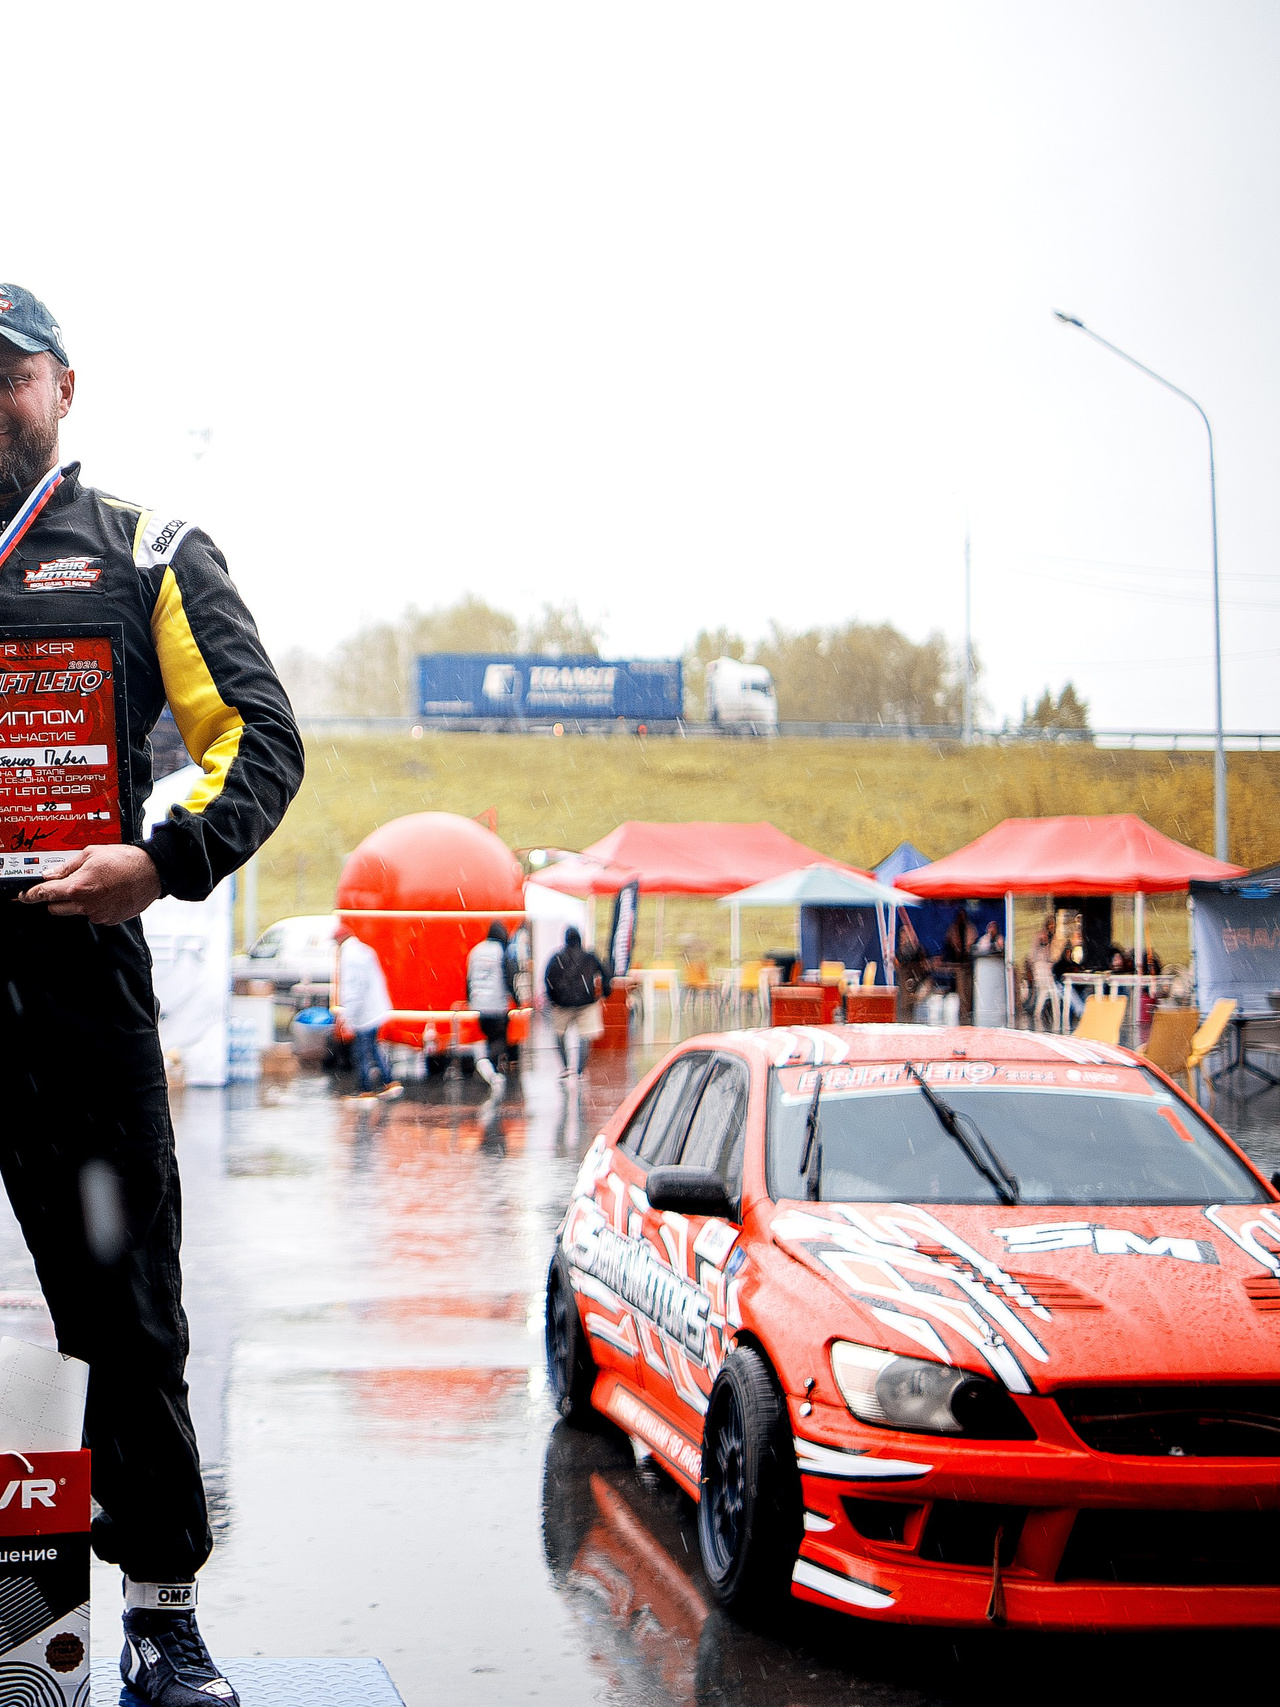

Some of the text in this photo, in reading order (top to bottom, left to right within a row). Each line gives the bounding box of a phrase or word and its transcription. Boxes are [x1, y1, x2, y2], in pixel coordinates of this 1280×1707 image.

[26, 570, 100, 581] MOTORS
[36, 669, 103, 694] LETO
[10, 731, 77, 744] УЧАСТИЕ
[44, 750, 87, 766] Павел
[35, 768, 66, 776] ЭТАПЕ
[47, 775, 63, 783] ПО
[65, 773, 106, 783] ДРИФТУ
[14, 786, 47, 796] LETO
[51, 784, 91, 795] 2026
[4, 813, 86, 823] КВАЛИФИКАЦИИ
[158, 1589, 191, 1603] OMP
[140, 1639, 158, 1664] OMP
